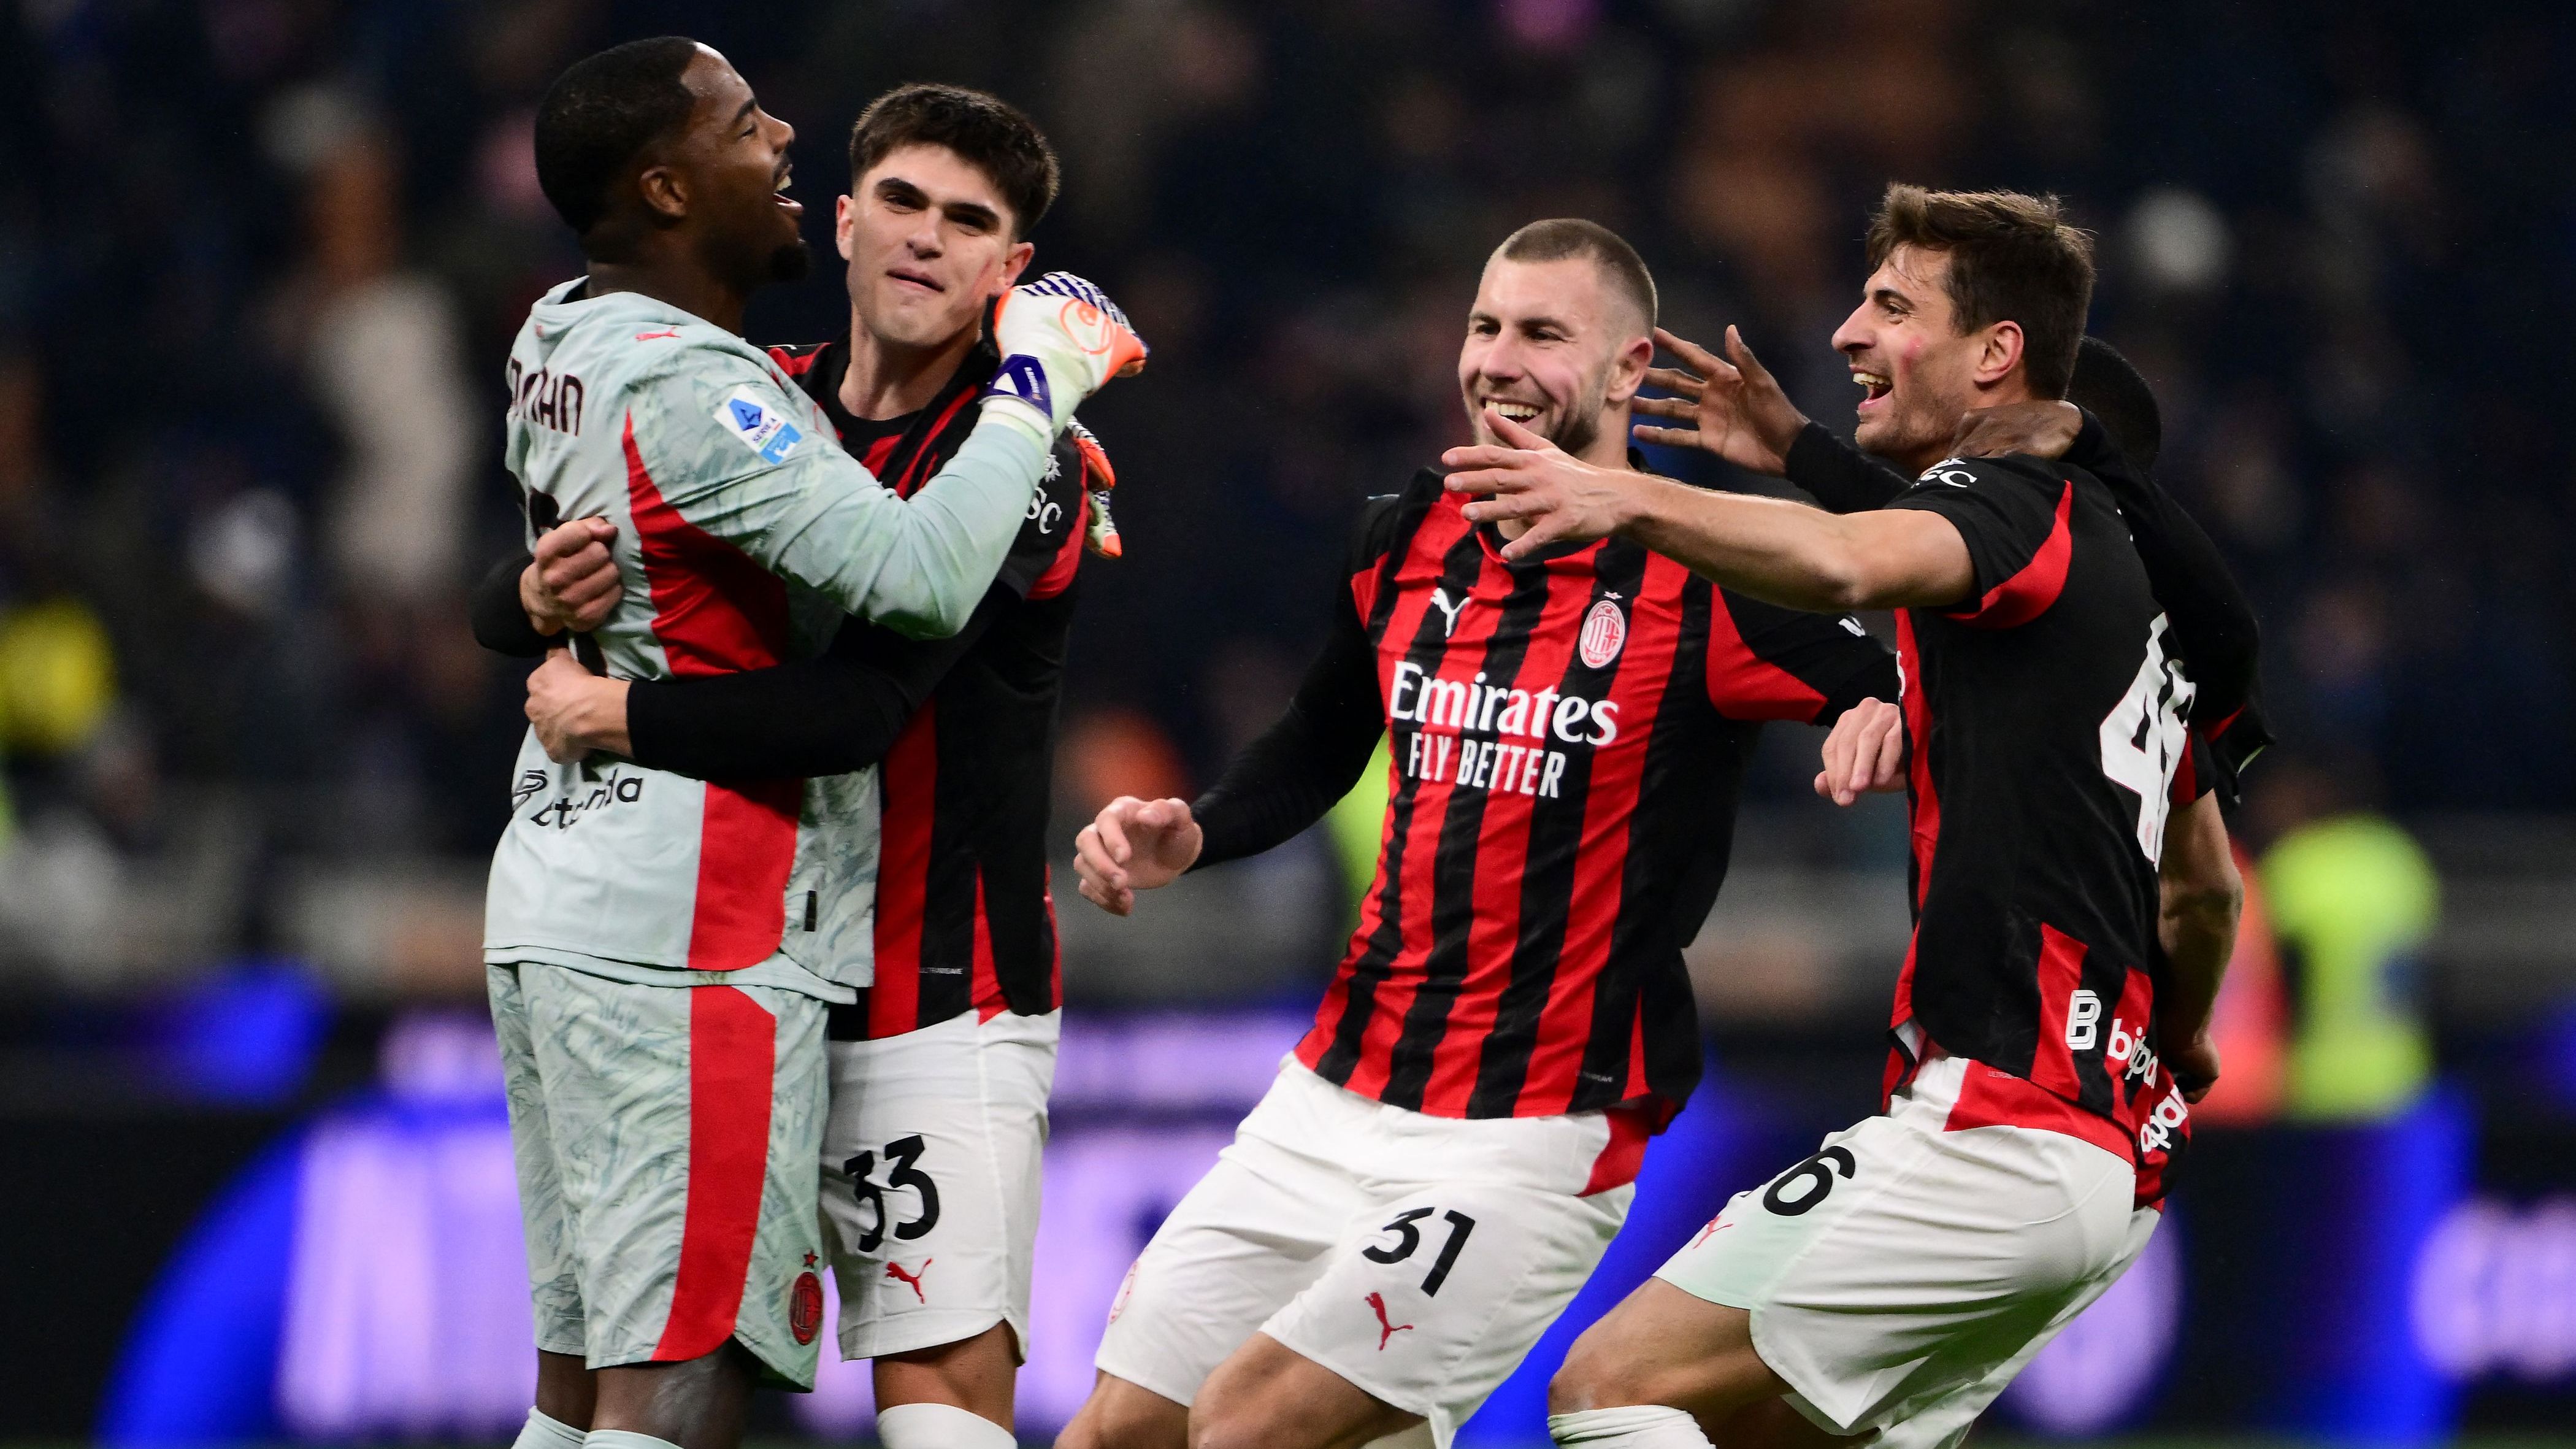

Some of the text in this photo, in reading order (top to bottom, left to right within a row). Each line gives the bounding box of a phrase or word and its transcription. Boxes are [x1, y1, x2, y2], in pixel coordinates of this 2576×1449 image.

[1389, 660, 1620, 747] Emirates
[1407, 732, 1566, 799] FLY BETTER
[844, 1134, 940, 1253] 33
[1362, 1206, 1476, 1298] 31
